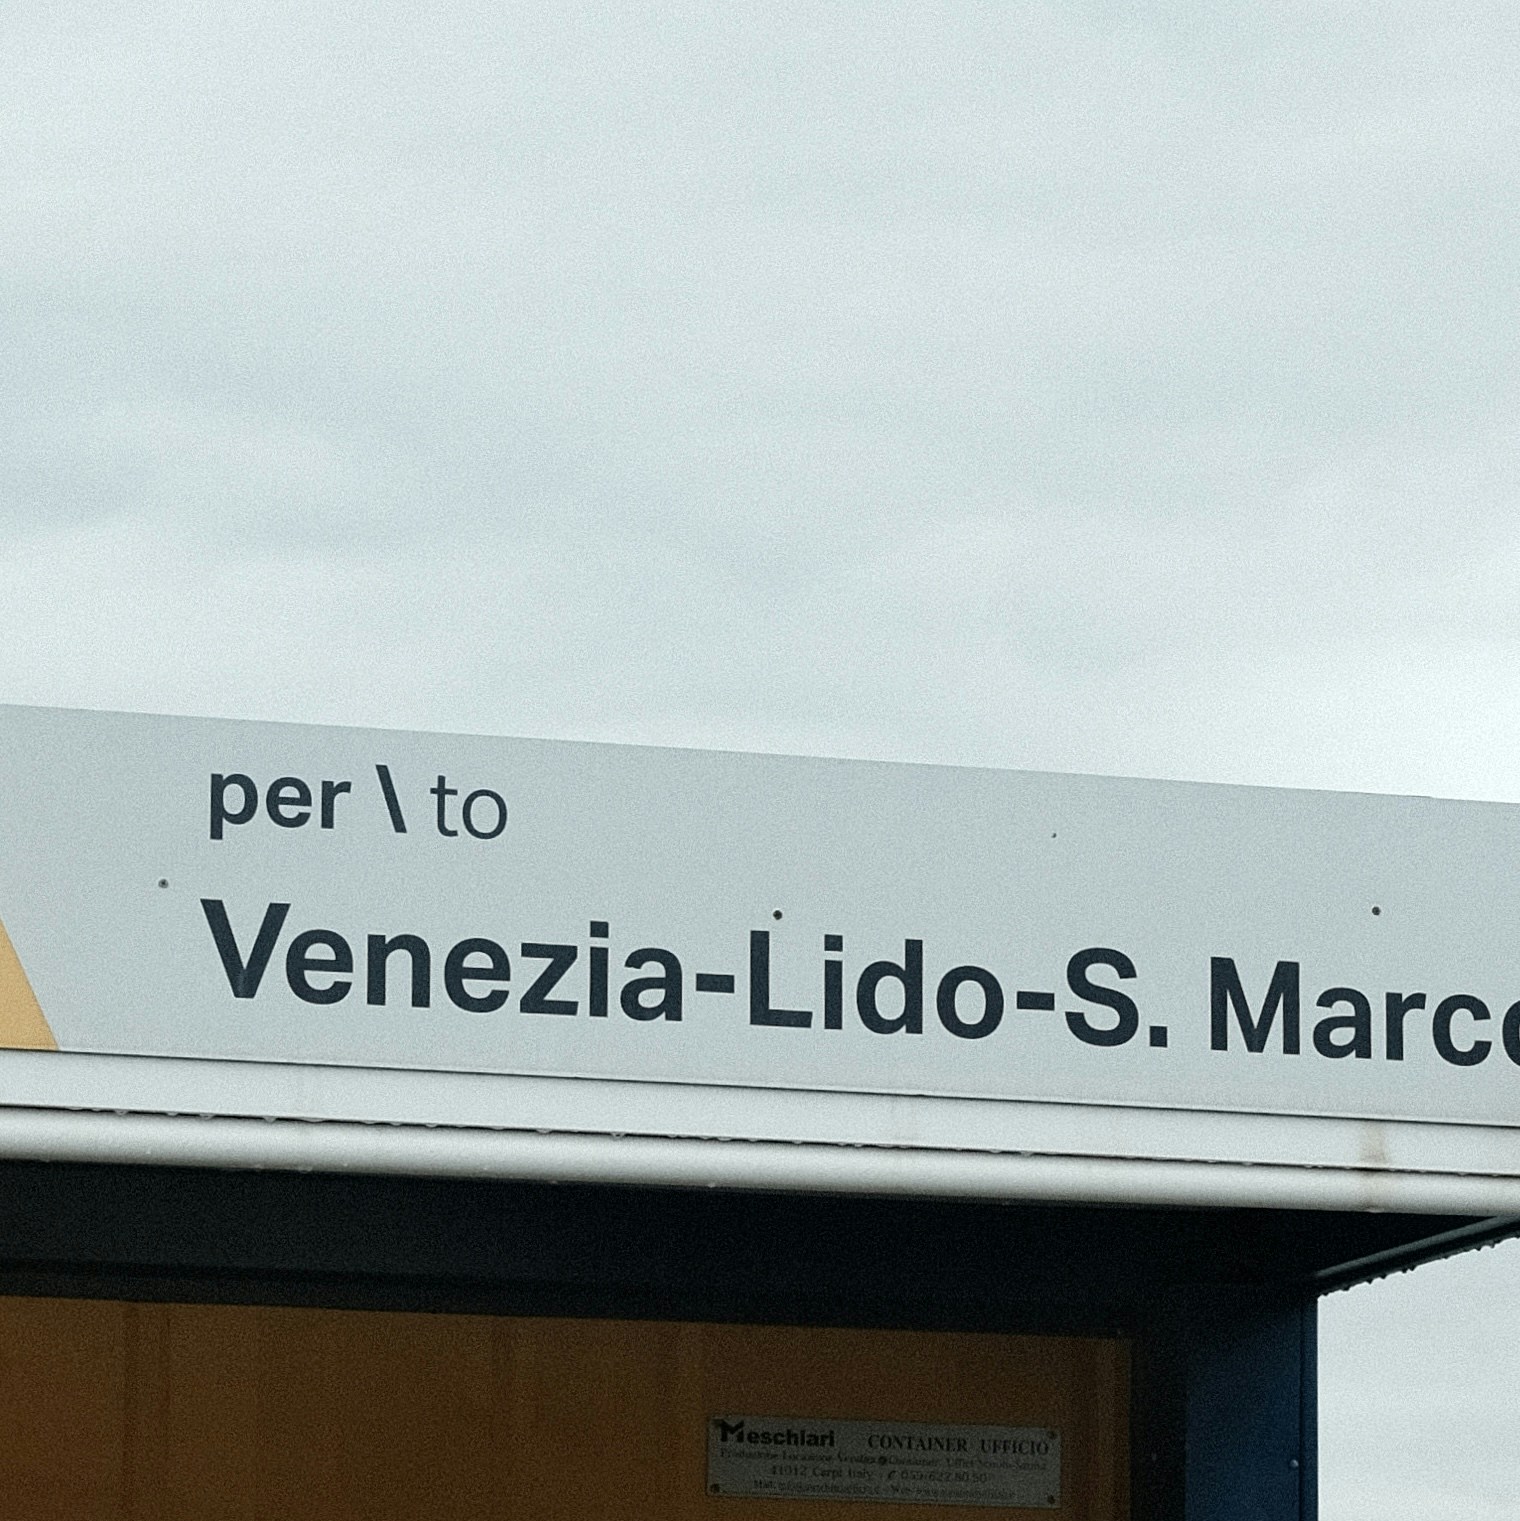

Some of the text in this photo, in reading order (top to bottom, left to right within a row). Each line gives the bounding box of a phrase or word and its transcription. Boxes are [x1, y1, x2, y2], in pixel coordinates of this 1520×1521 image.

[210, 774, 351, 837] per
[430, 773, 508, 840] to
[201, 898, 1169, 1050] Venezia-Lido-S.
[713, 1419, 1050, 1457] Meschiari CONTAINER UFFICIO
